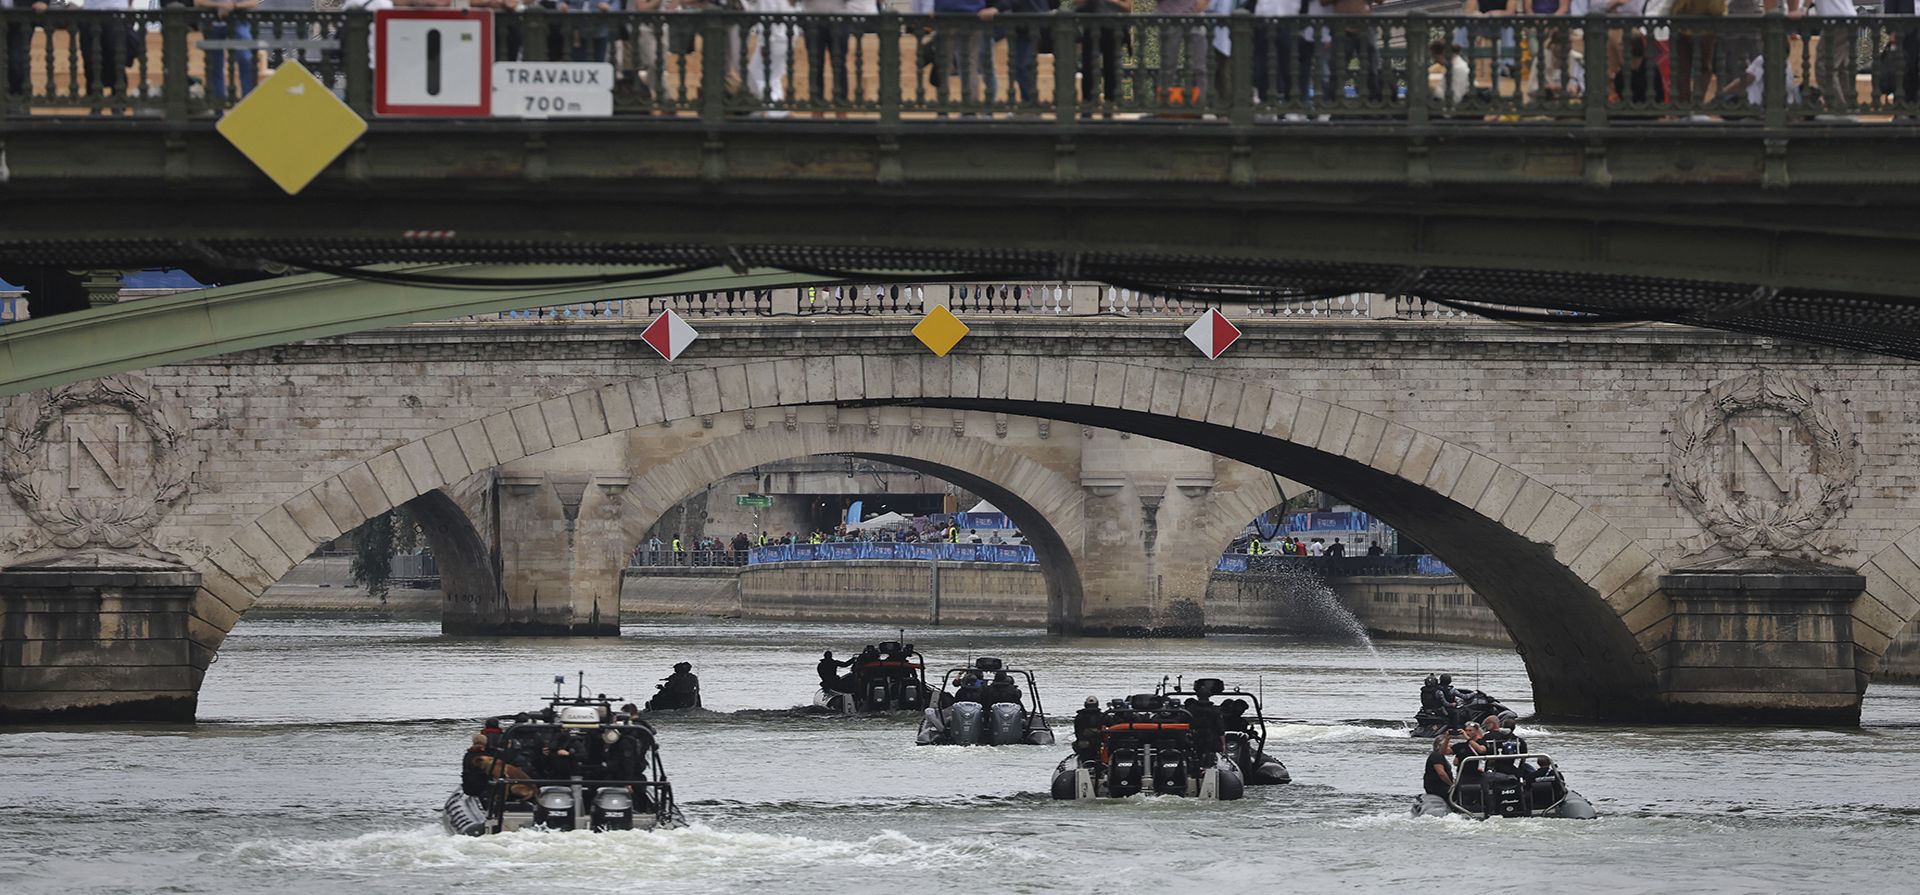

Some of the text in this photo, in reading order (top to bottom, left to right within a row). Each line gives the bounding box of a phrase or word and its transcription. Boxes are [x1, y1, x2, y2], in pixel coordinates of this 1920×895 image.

[507, 69, 599, 84] TRAVAUX
[524, 96, 581, 111] 700m
[67, 422, 129, 490] N
[1732, 426, 1792, 493] N
